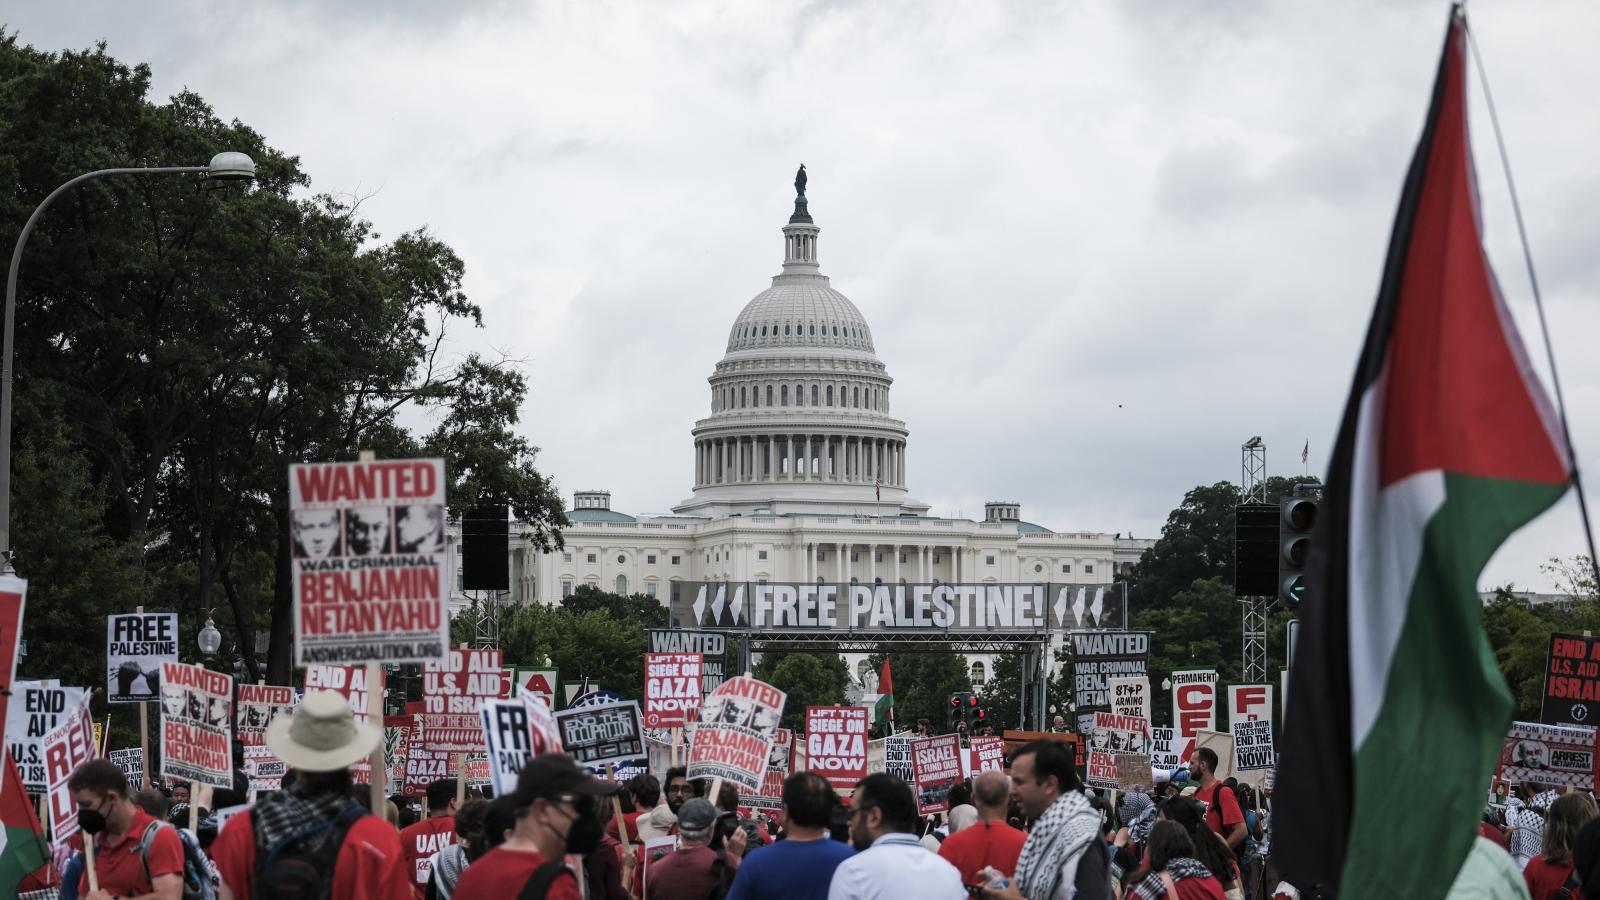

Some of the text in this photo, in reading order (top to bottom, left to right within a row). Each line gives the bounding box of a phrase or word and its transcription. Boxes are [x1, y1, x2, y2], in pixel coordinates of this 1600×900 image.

[296, 463, 436, 503] WANTED
[300, 556, 438, 571] WAR CRIMINAL
[300, 567, 439, 604] BENJAMIN
[755, 585, 1044, 627] FREE PALESTINE!
[301, 601, 440, 636] NETANYAHU
[114, 616, 171, 641] FREE
[110, 642, 175, 656] PALESTINE
[651, 632, 725, 655] WANTED
[1075, 634, 1147, 654] WANTED
[1553, 639, 1587, 658] END
[468, 651, 502, 672] ALL
[1075, 661, 1147, 674] WAR CRIMINAL
[1551, 658, 1598, 677] U.S. AID
[307, 666, 346, 689] END
[648, 664, 699, 676] SIEGE ON
[164, 663, 229, 697] WANTED
[425, 673, 461, 695] U.S.
[466, 673, 500, 695] AID
[1172, 672, 1216, 684] PERMANENT
[648, 678, 699, 699] GAZA
[26, 689, 66, 713] END
[426, 696, 483, 713] TO ISRA
[648, 700, 699, 711] NOW
[1115, 696, 1143, 706] ARMING
[425, 714, 444, 727] STOP
[447, 715, 460, 727] THE
[566, 711, 631, 730] END THE
[810, 709, 865, 718] LIFT THE
[165, 716, 187, 726] WAR
[190, 718, 228, 735] CRIMINAL
[567, 720, 634, 745] OCCUPATION
[697, 722, 718, 730] WAR
[721, 723, 770, 743] CRIMINAL
[809, 719, 864, 733] SIEGE ON
[1234, 720, 1269, 730] STAND WITH
[1234, 727, 1270, 736] PALESTINE!
[1513, 724, 1588, 739] FROM THE RIVER
[165, 722, 228, 754] BENJAMIN
[1153, 729, 1173, 740] END
[1236, 734, 1271, 747] END THE
[694, 729, 769, 760] BENJAMIN
[809, 733, 865, 756] GAZA
[914, 741, 930, 751] STOP
[931, 737, 956, 748] ARMING
[1154, 741, 1171, 752] ALL
[1236, 745, 1272, 754] OCCUPATION
[111, 751, 129, 760] STAND
[165, 741, 228, 773] NETANYAHU
[409, 750, 448, 760] SIEGE ON
[691, 745, 765, 775] NETANYAHU
[887, 752, 904, 761] END
[915, 749, 957, 767] ISRAEL
[979, 748, 1002, 760] SIEGE
[1164, 754, 1178, 764] AID
[1237, 752, 1272, 767] NOW!
[1551, 750, 1591, 763] ARREST
[258, 762, 285, 770] ARREST
[406, 760, 447, 775] GAZA
[809, 757, 865, 770] NOW
[923, 762, 943, 774] FUND
[943, 759, 959, 770] OUR
[918, 769, 960, 783] COMMUNITIES
[416, 831, 452, 853] UAW
